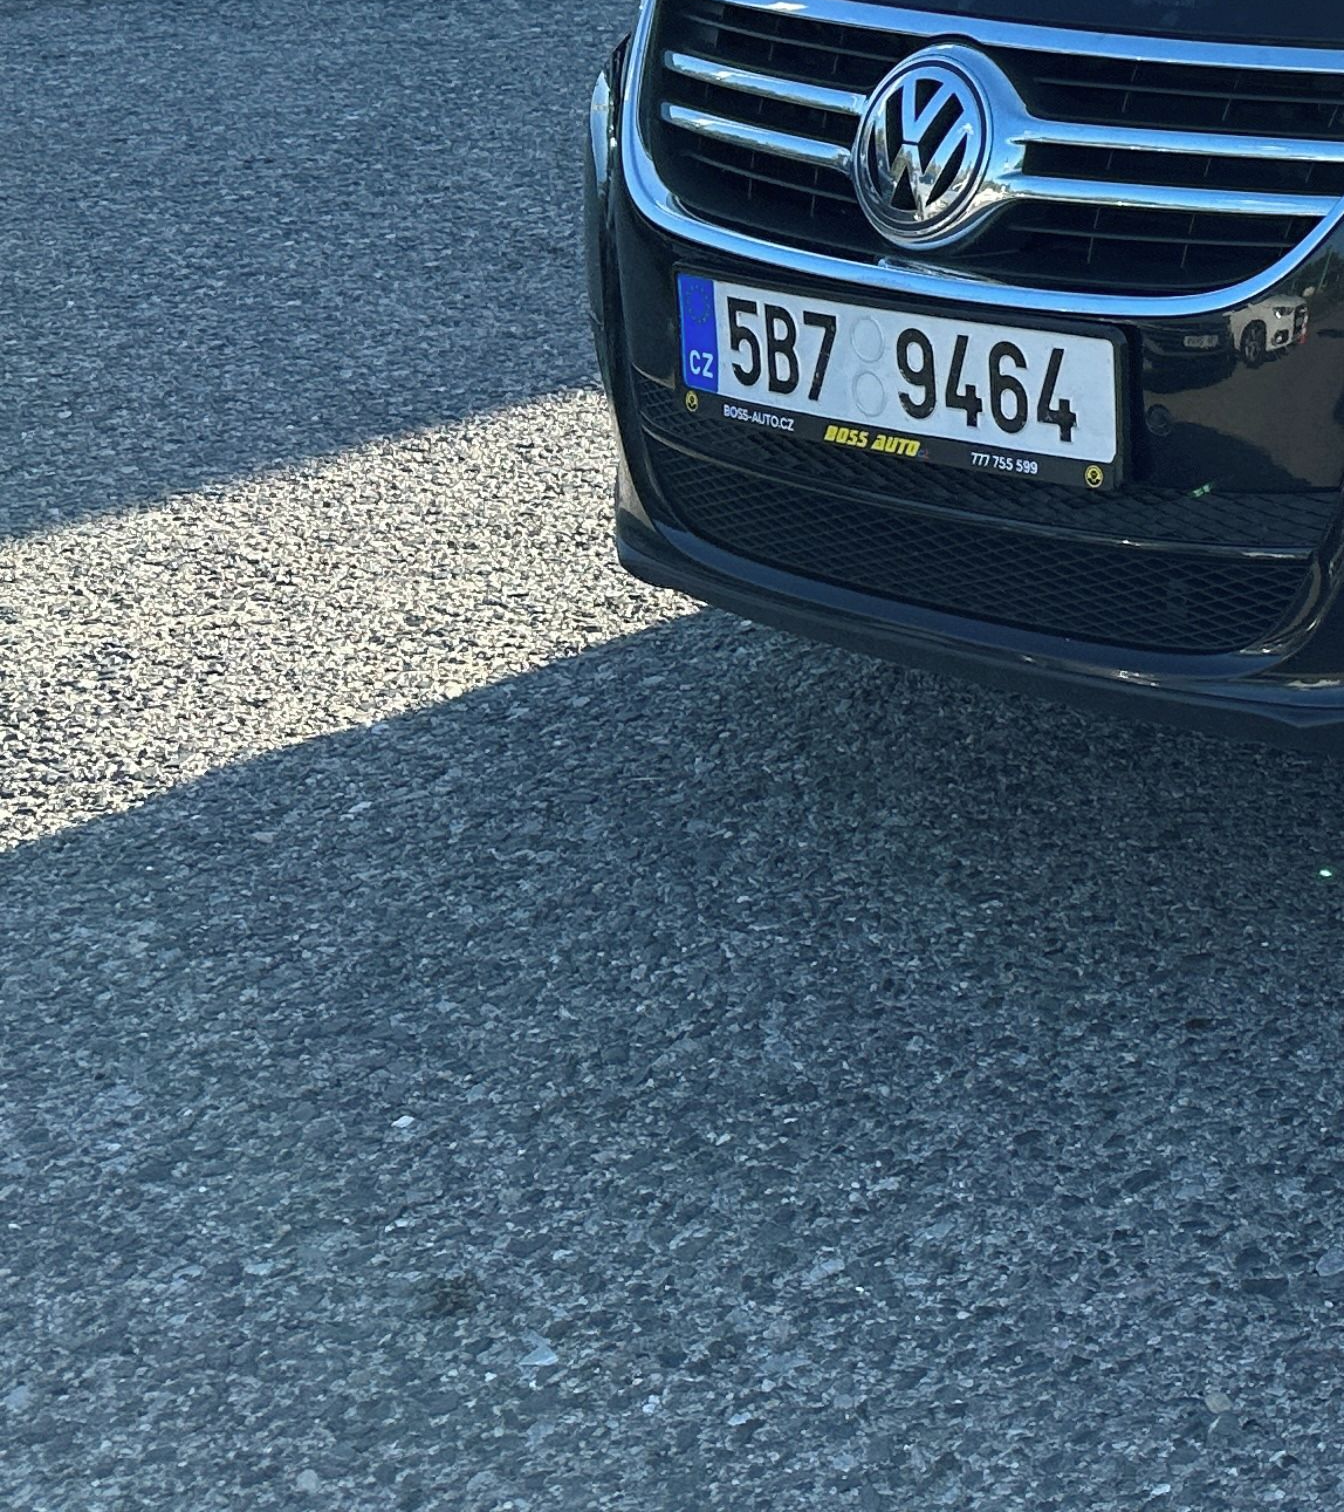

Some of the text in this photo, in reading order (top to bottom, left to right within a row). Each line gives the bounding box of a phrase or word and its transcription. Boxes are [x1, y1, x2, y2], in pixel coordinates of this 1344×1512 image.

[689, 296, 1078, 443] CZ 5B7 9464
[723, 403, 795, 432] BOSS-AUTO.CZ
[824, 424, 869, 448] BOSS
[871, 434, 921, 457] AUTO
[971, 450, 990, 467] 777
[992, 454, 1014, 471] 755
[1016, 457, 1039, 475] 599
